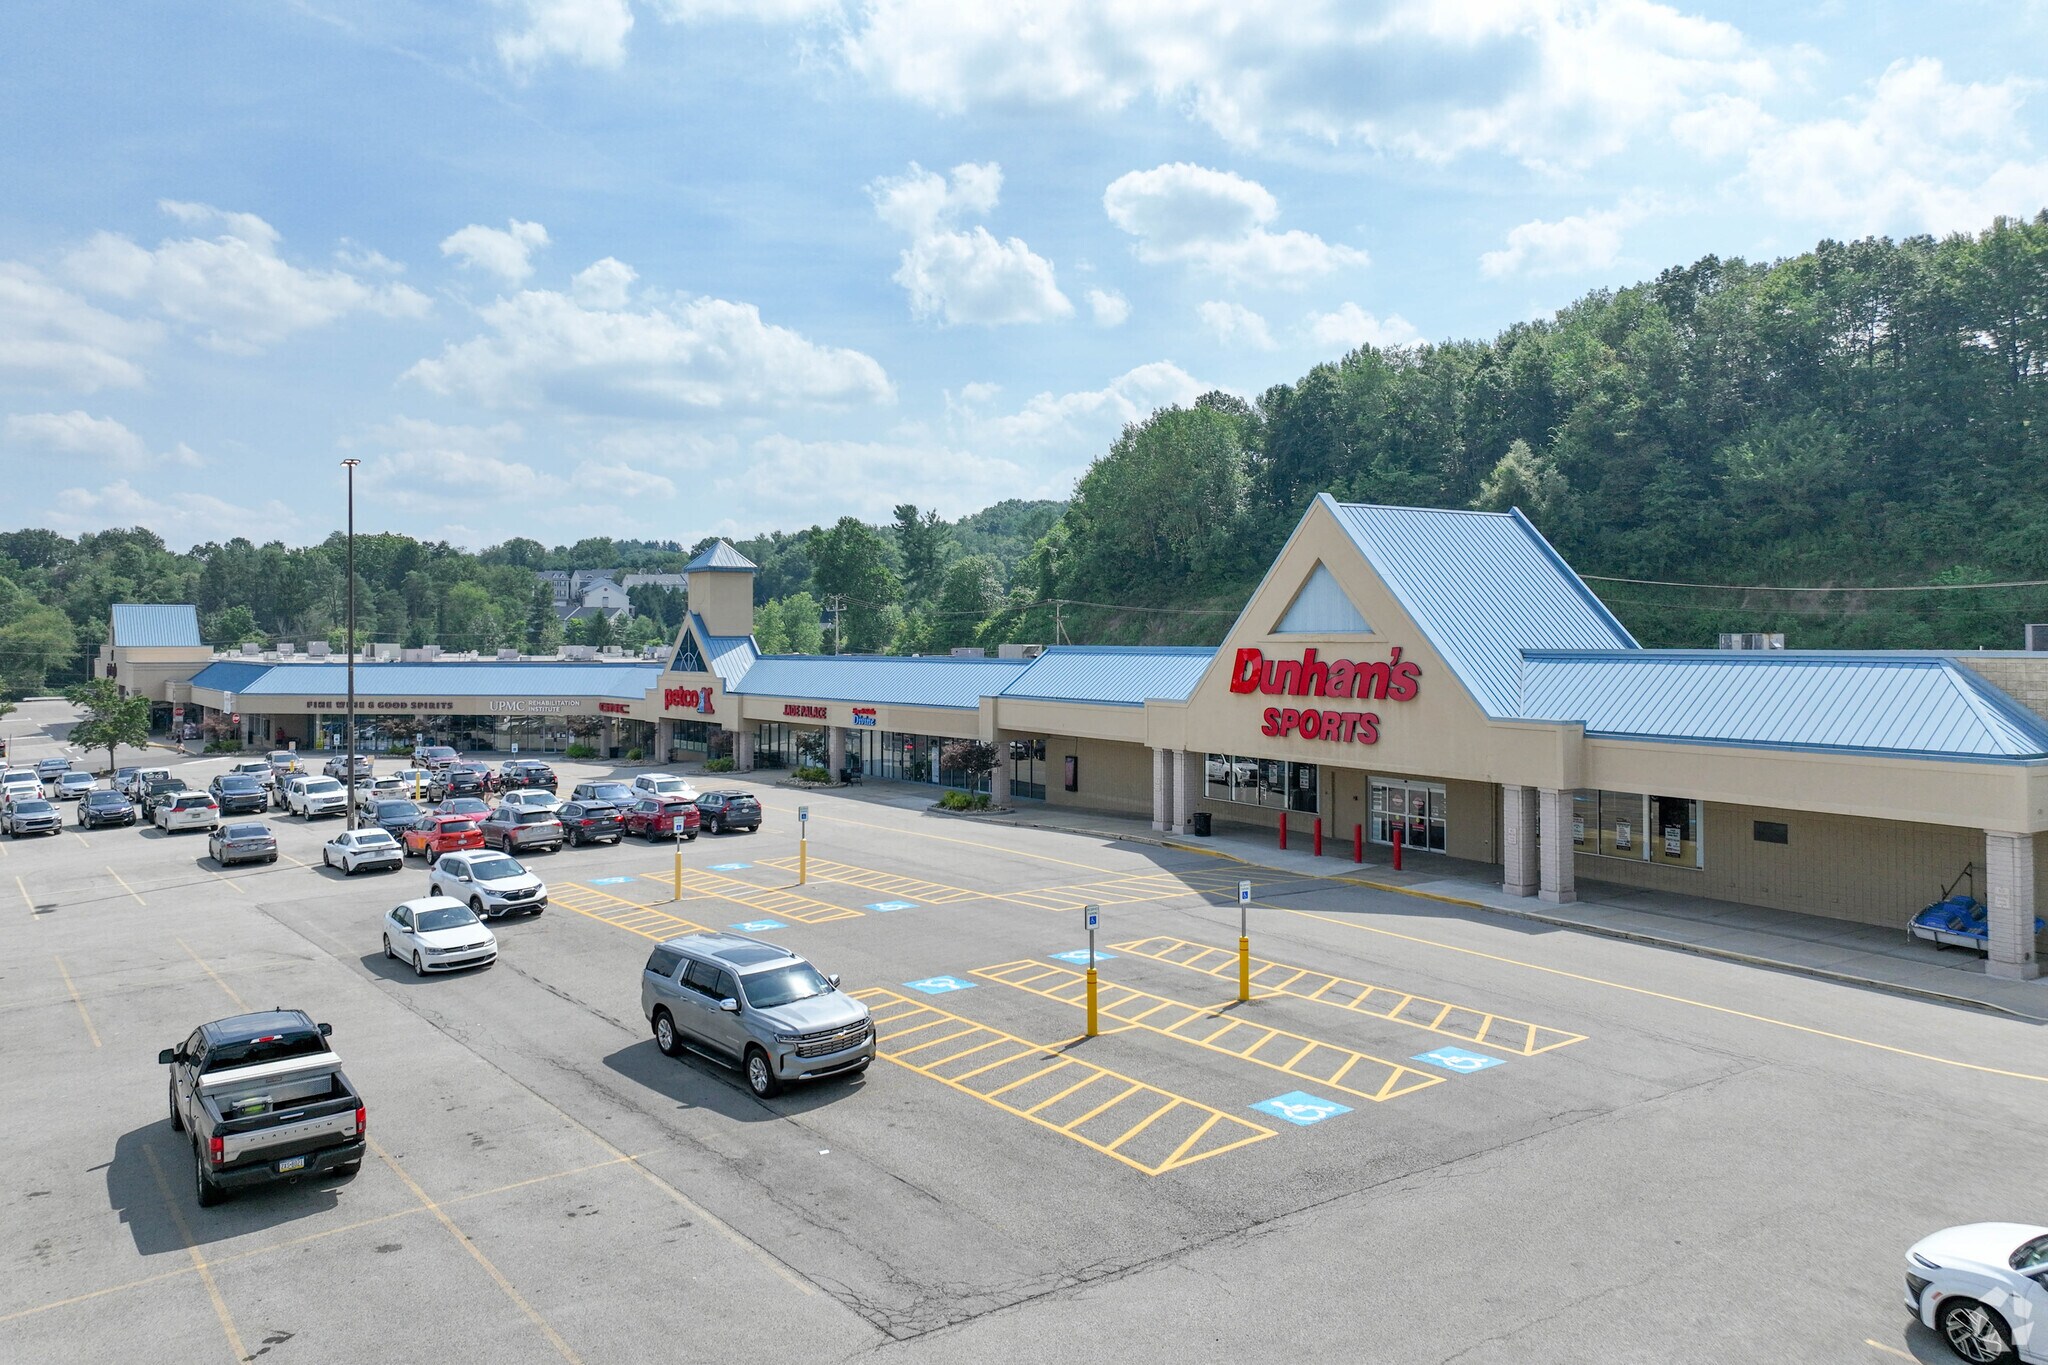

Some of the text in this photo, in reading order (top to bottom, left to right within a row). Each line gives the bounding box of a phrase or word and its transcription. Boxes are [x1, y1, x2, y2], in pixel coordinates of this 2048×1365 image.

[1229, 646, 1422, 702] Dunham's
[306, 701, 332, 709] FINE
[367, 701, 375, 709] &
[377, 701, 408, 709] GOOD
[410, 701, 454, 710] SPIRITS
[489, 701, 525, 712] UPMC
[664, 685, 699, 711] petco
[783, 704, 827, 719] JADE PALACE
[853, 714, 876, 726] Divine
[1261, 707, 1380, 745] SPORTS
[250, 1122, 333, 1142] PLATINUM
